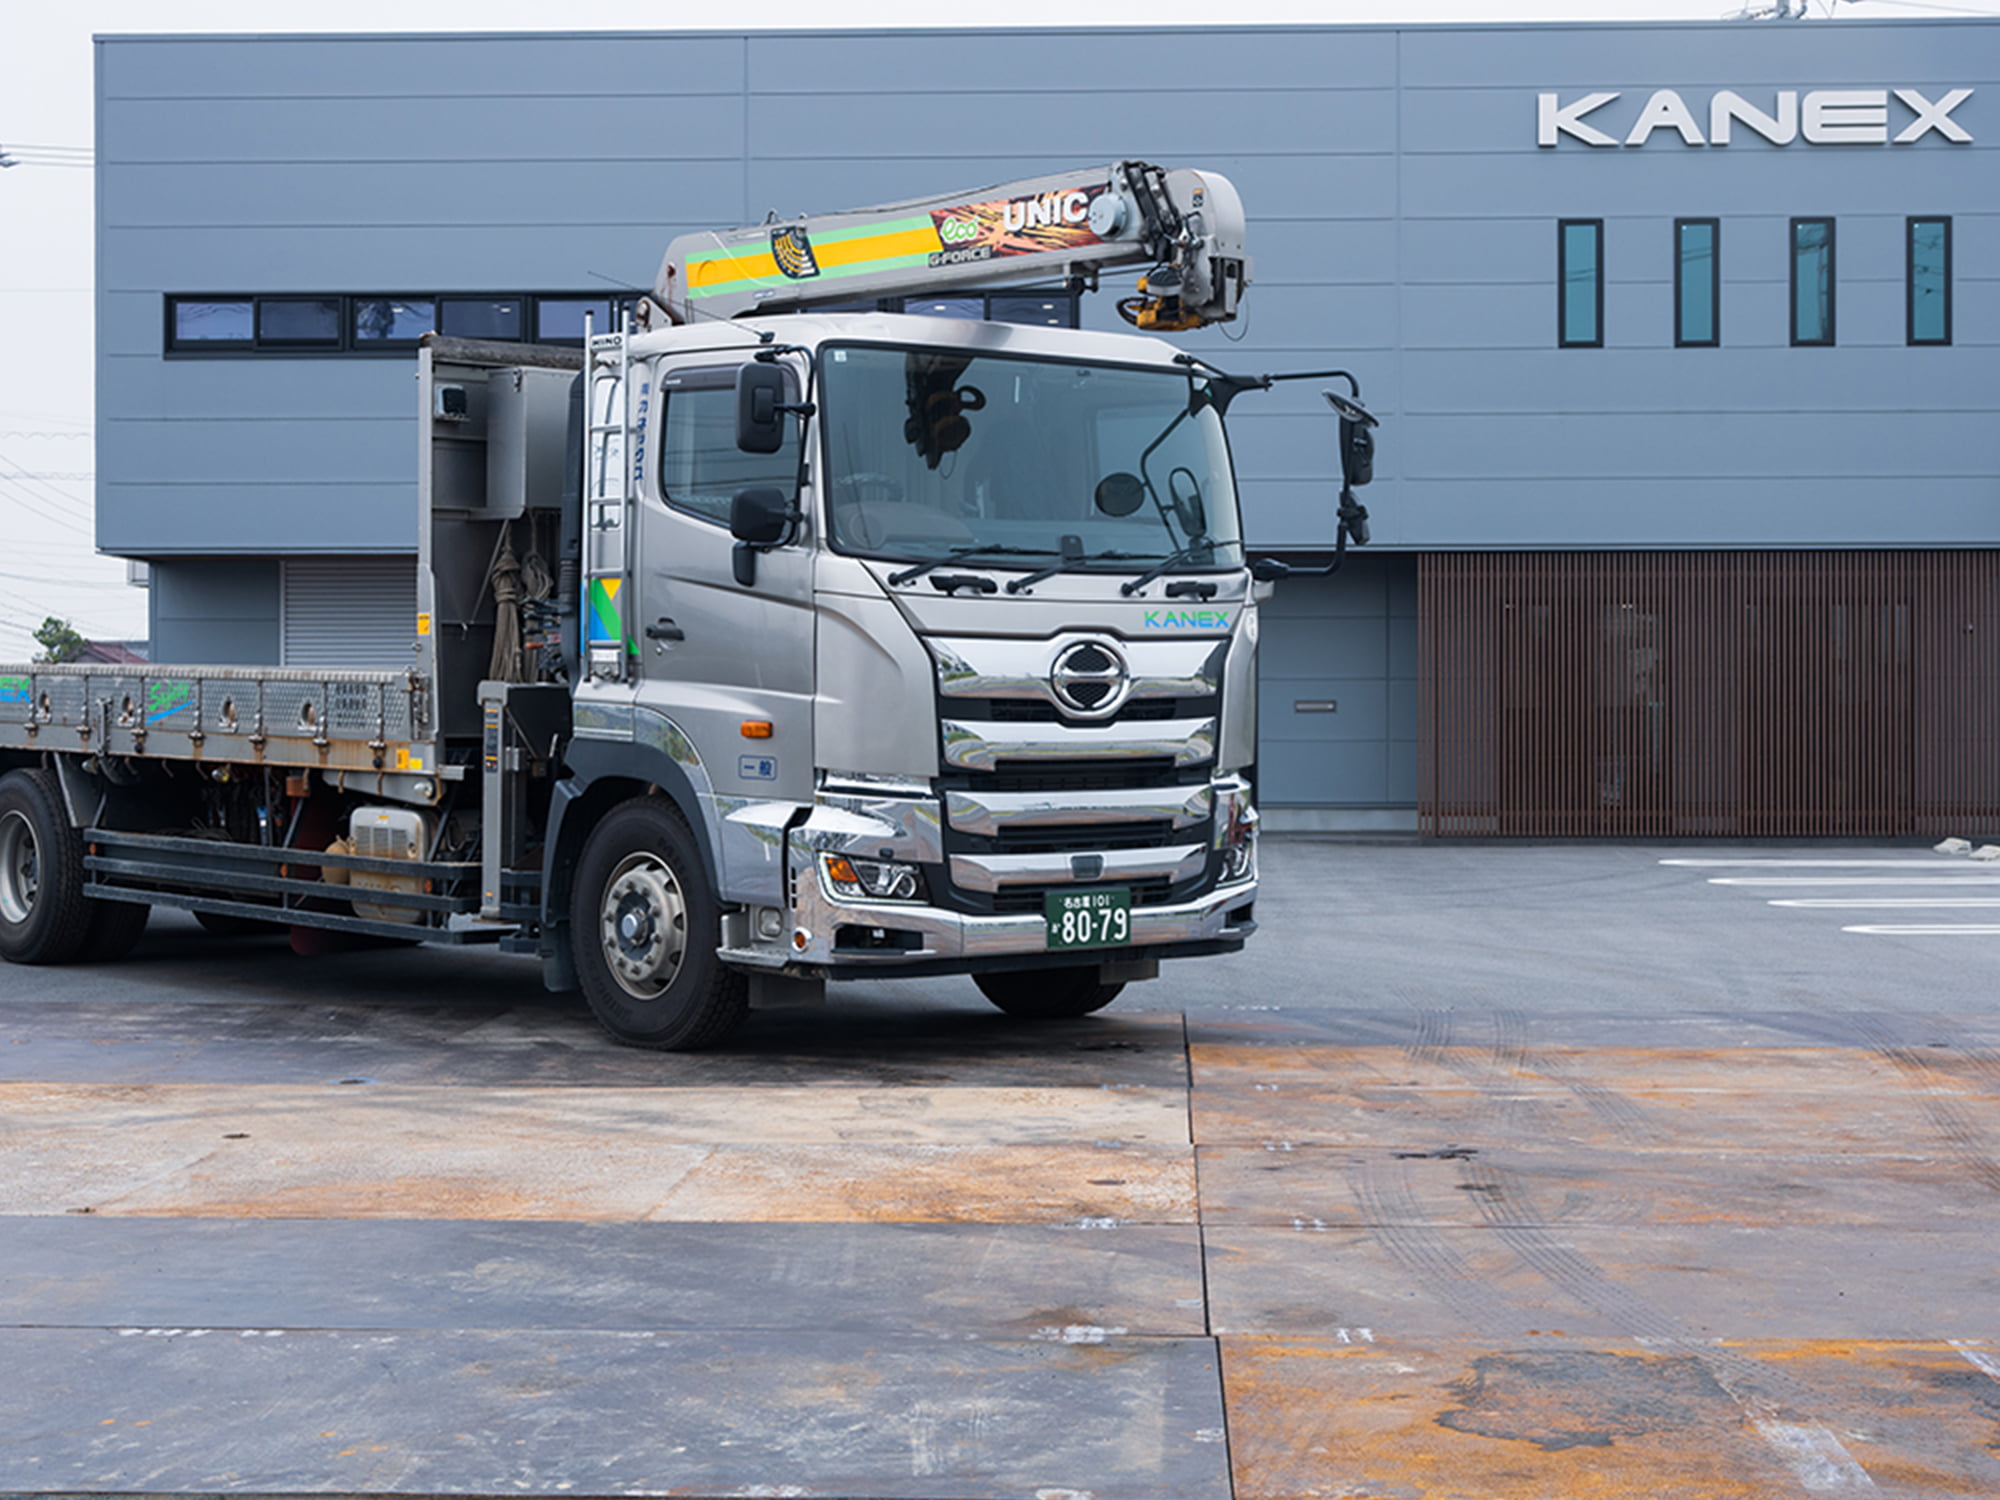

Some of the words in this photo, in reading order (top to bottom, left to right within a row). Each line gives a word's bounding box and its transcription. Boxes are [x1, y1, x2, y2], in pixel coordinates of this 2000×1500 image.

[1537, 88, 1975, 147] KANEX
[1004, 191, 1089, 232] UNIC
[941, 217, 979, 243] eco
[929, 247, 992, 267] G-FORCE
[1143, 610, 1231, 629] KANEX
[743, 760, 772, 776] 一般
[1062, 907, 1127, 944] 80-79
